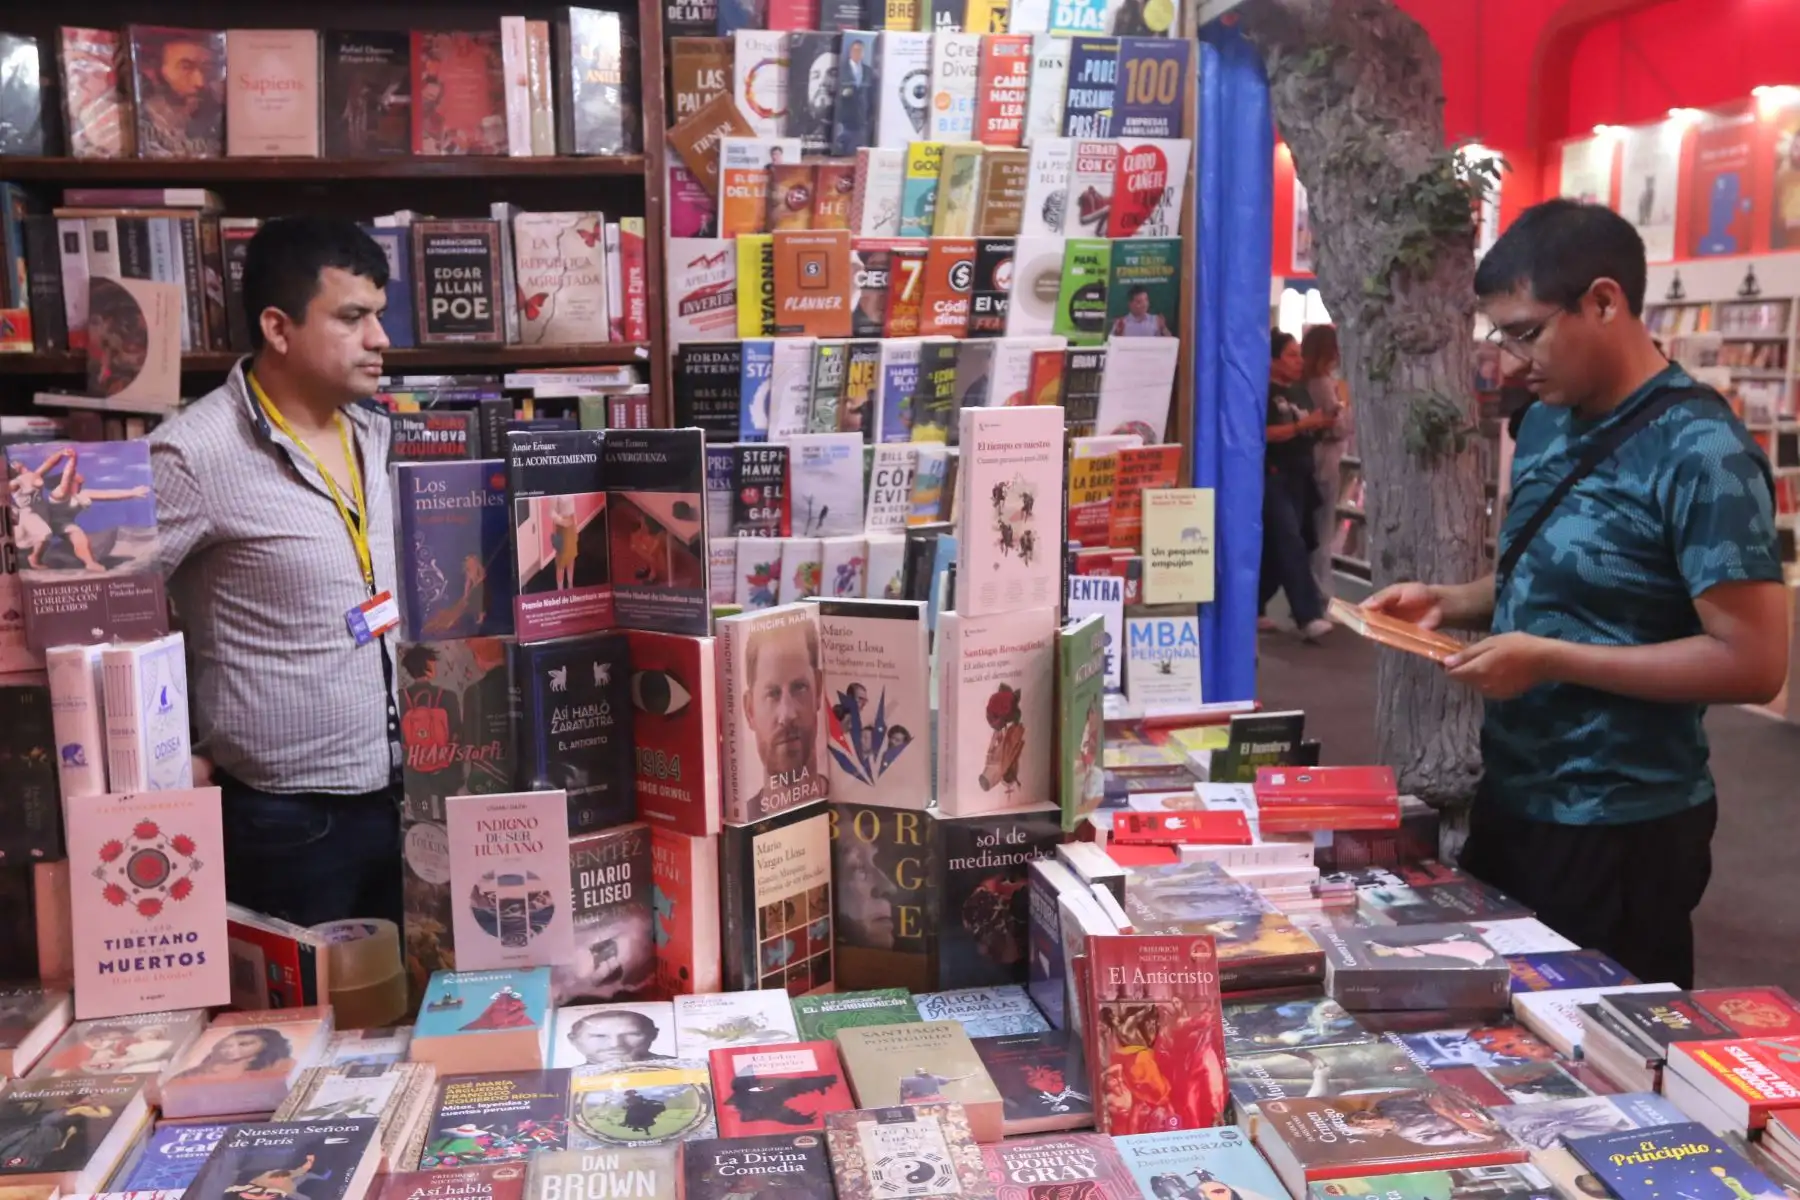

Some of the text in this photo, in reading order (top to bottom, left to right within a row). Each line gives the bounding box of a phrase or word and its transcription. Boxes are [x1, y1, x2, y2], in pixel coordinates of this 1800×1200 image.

[239, 74, 305, 97] Sapiens
[696, 69, 725, 89] LAS
[1125, 59, 1179, 105] 100
[1078, 159, 1102, 172] CON
[531, 238, 549, 250] LA
[433, 267, 482, 279] EDGAR
[900, 259, 923, 302] 7
[434, 280, 484, 294] ALLAN
[628, 266, 645, 324] Jane Eyre
[431, 297, 490, 320] POE
[783, 295, 843, 311] PLANNER
[975, 297, 992, 311] El
[684, 352, 741, 364] JORDAN
[402, 419, 425, 431] libro
[421, 430, 467, 443] nueva
[511, 443, 532, 452] Annie
[977, 442, 986, 451] El
[512, 453, 598, 467] EL ACONTECIMIENTO
[880, 451, 903, 462] BILL
[741, 463, 782, 476] HAWK
[414, 476, 447, 494] Los
[1072, 477, 1088, 489] LA
[763, 486, 783, 498] EL
[415, 490, 505, 512] miserables
[1151, 546, 1210, 560] Un pequeño
[1151, 558, 1194, 571] empujón
[32, 582, 102, 597] MUJERES QUE
[33, 592, 99, 606] CORREN CON
[521, 600, 544, 611] Premio
[34, 602, 88, 615] LOS LOBOS
[821, 623, 854, 637] Mario
[1129, 621, 1198, 648] MBA
[820, 638, 884, 655] Vargas Llosa
[964, 648, 998, 658] Santiago
[1130, 646, 1198, 660] PERSONAL
[1240, 742, 1251, 756] El
[635, 746, 682, 784] 1984
[769, 766, 810, 790] EN LA
[658, 784, 692, 803] ORWELL
[760, 782, 820, 812] SOMBRA
[476, 816, 540, 834] INDIGNO
[485, 831, 532, 843] DE SER
[976, 825, 1027, 848] sol de
[474, 841, 545, 858] HUMANO
[757, 840, 782, 856] Mario
[757, 847, 806, 871] Vargas Llosa
[949, 846, 1054, 871] medianoche
[579, 862, 632, 890] DIARIO
[896, 857, 924, 891] G
[583, 884, 633, 909] ELISEO
[897, 905, 924, 939] E
[104, 931, 199, 951] TIBETANO
[1138, 944, 1180, 954] FRIEDRICH
[98, 951, 207, 975] MUERTOS
[1138, 953, 1181, 963] NIETZSCHE
[1107, 964, 1215, 986] El Anticristo
[802, 998, 908, 1015] EL NECRONOMICÓN
[926, 993, 991, 1010] ALICIA
[928, 1001, 1020, 1021] MARAVILLAS
[861, 1026, 951, 1037] SANTIAGO
[446, 1081, 474, 1090] JOSÉ
[1732, 1066, 1785, 1099] PODER
[8, 1085, 133, 1100] Madame Bovary
[445, 1086, 510, 1095] ARGUEDAS
[445, 1090, 511, 1100] FRANCISCO
[444, 1096, 509, 1105] IZQUIERDO
[440, 1105, 532, 1117] cuentos peruanos
[236, 1124, 360, 1139] Nuestra Señora
[228, 1136, 295, 1149] de París
[1012, 1141, 1077, 1153] Oscar Wilde
[1126, 1138, 1142, 1146] Los
[1132, 1138, 1244, 1158] Karamazov
[1638, 1141, 1655, 1153] El
[713, 1151, 809, 1167] La Divina
[1016, 1149, 1072, 1160] RETRATO
[1608, 1143, 1711, 1168] Principito
[581, 1154, 620, 1173] DAN
[717, 1162, 806, 1177] Comedia
[1005, 1154, 1097, 1171] DORIAN
[1010, 1162, 1098, 1185] GRAY
[410, 1186, 441, 1197] Así
[445, 1183, 493, 1195] habló
[541, 1170, 656, 1200] BROWN
